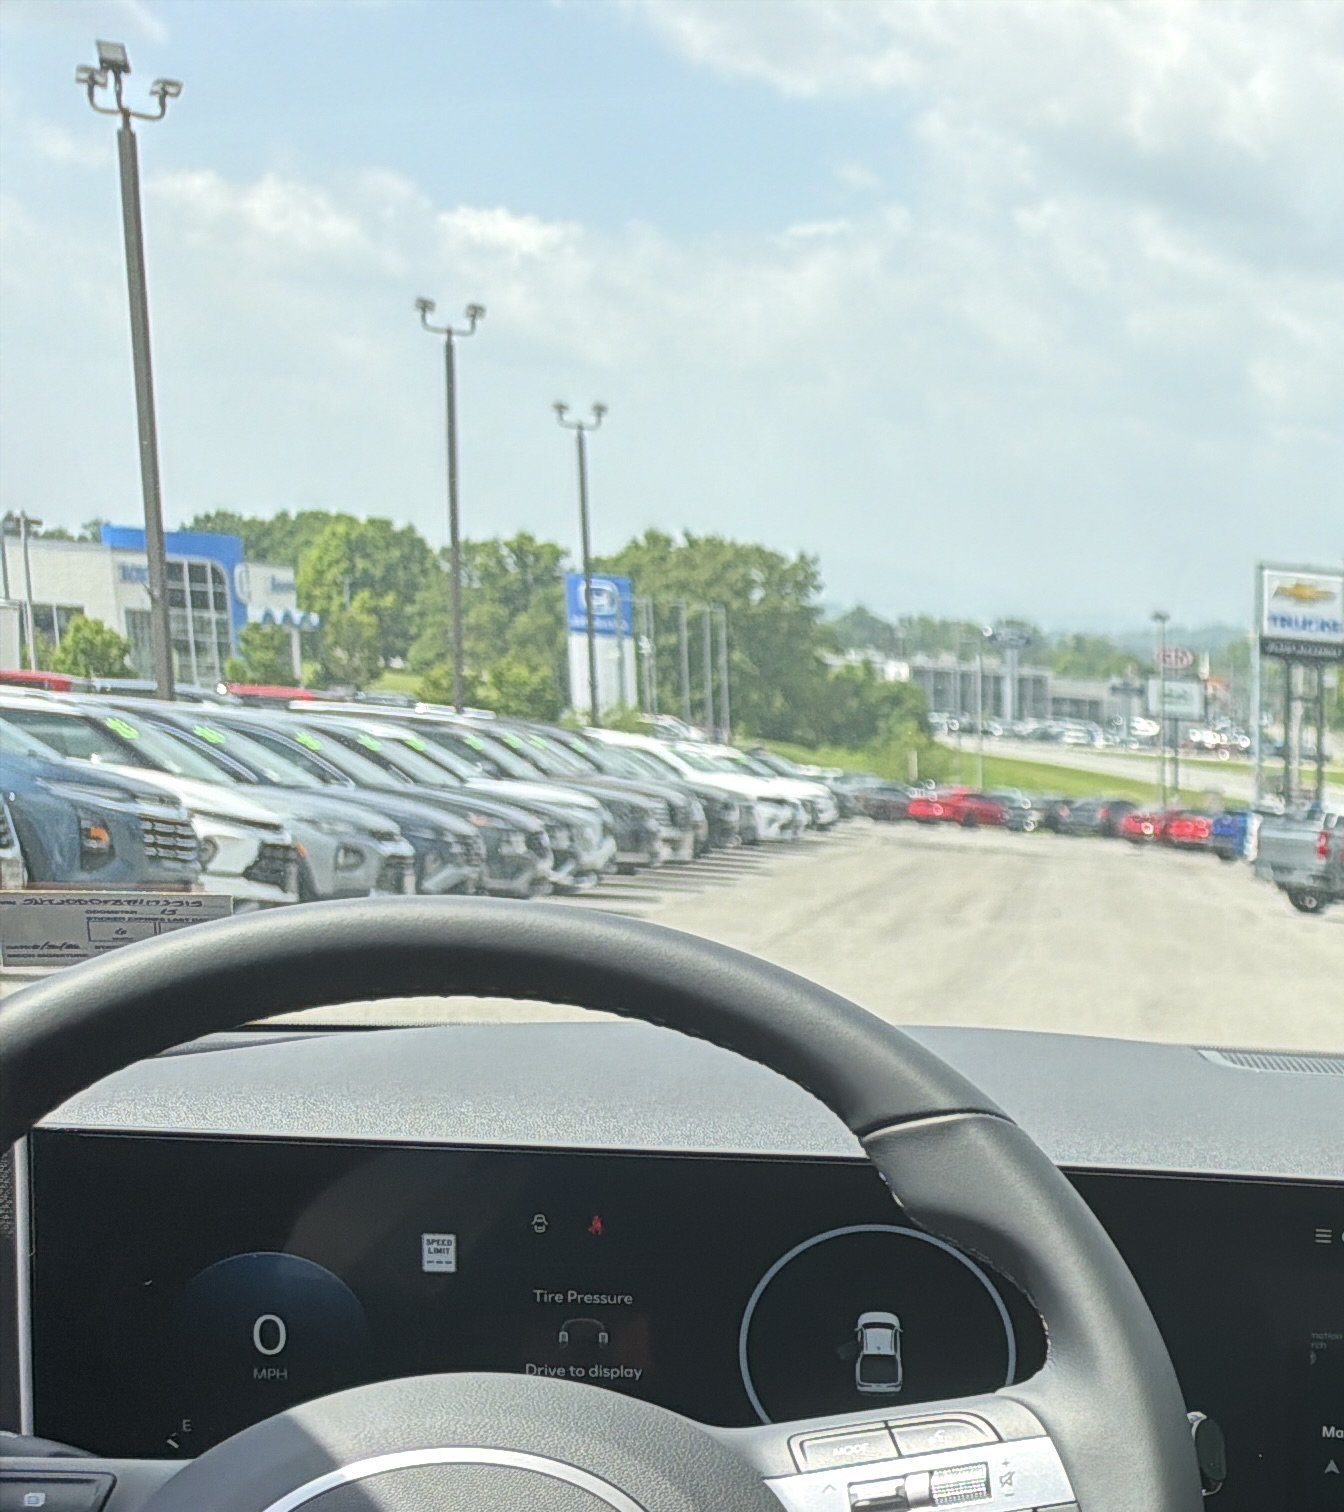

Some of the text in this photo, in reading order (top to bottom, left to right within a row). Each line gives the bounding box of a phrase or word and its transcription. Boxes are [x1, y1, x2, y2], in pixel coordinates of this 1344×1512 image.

[425, 1238, 453, 1246] SPEED
[427, 1247, 451, 1255] LIMIT
[533, 1289, 633, 1305] Tire Pressure
[253, 1314, 287, 1356] 0
[253, 1367, 288, 1380] MPH
[525, 1363, 643, 1381] Drive to display
[182, 1419, 192, 1432] E
